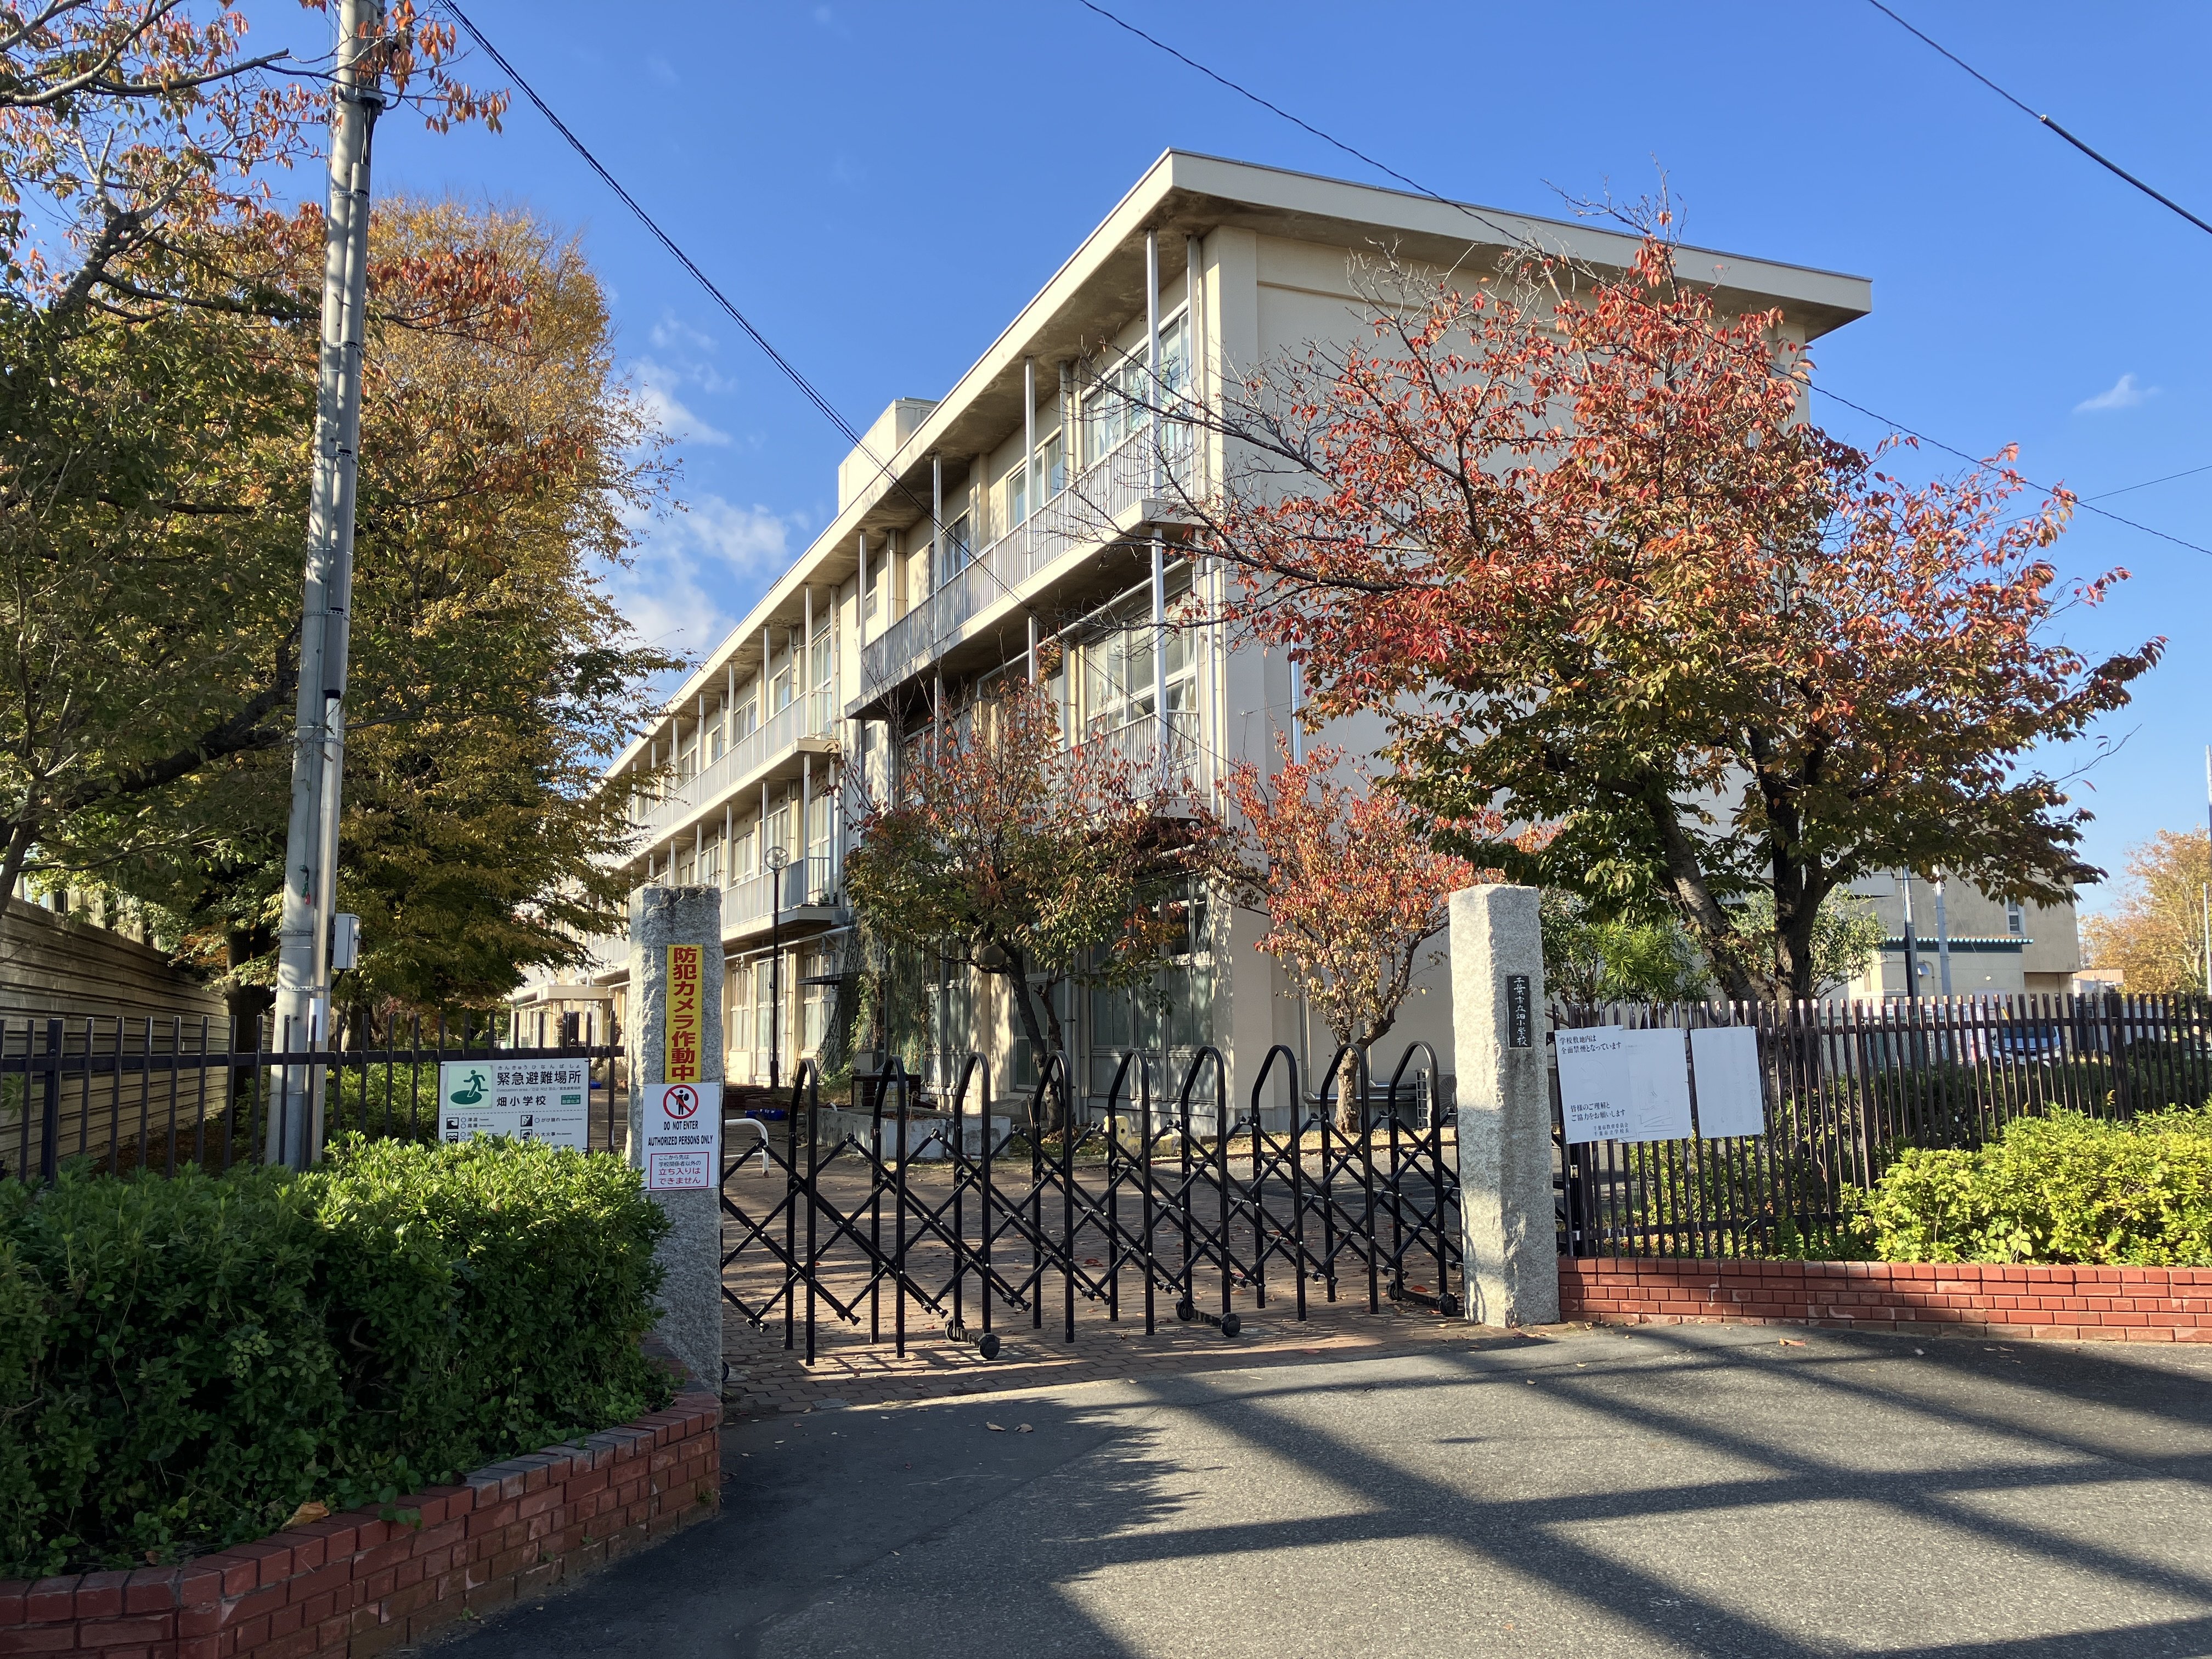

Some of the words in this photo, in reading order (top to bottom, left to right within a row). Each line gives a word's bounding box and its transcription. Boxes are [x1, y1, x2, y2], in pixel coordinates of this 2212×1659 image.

[671, 947, 697, 1081] 防犯カメラ作動中
[1514, 977, 1528, 1046] 千葉市立畑小学校
[1559, 1034, 1596, 1045] 学校敷地内は
[1561, 1041, 1622, 1054] 全面禁煙となっています
[497, 1070, 582, 1086] 緊急避難場所
[496, 1096, 546, 1107] 畑小学校
[1571, 1102, 1610, 1113] 皆様のご理解と
[1571, 1109, 1626, 1121] ご協力をお願いします
[664, 1121, 670, 1130] DO
[673, 1121, 682, 1130] NOT
[683, 1120, 698, 1130] ENTER
[648, 1136, 678, 1146] AUTHORIZED
[678, 1135, 699, 1145] PERSONS
[701, 1135, 713, 1144] ONLY
[658, 1167, 701, 1176] 立ち入りは
[658, 1177, 701, 1185] できません
